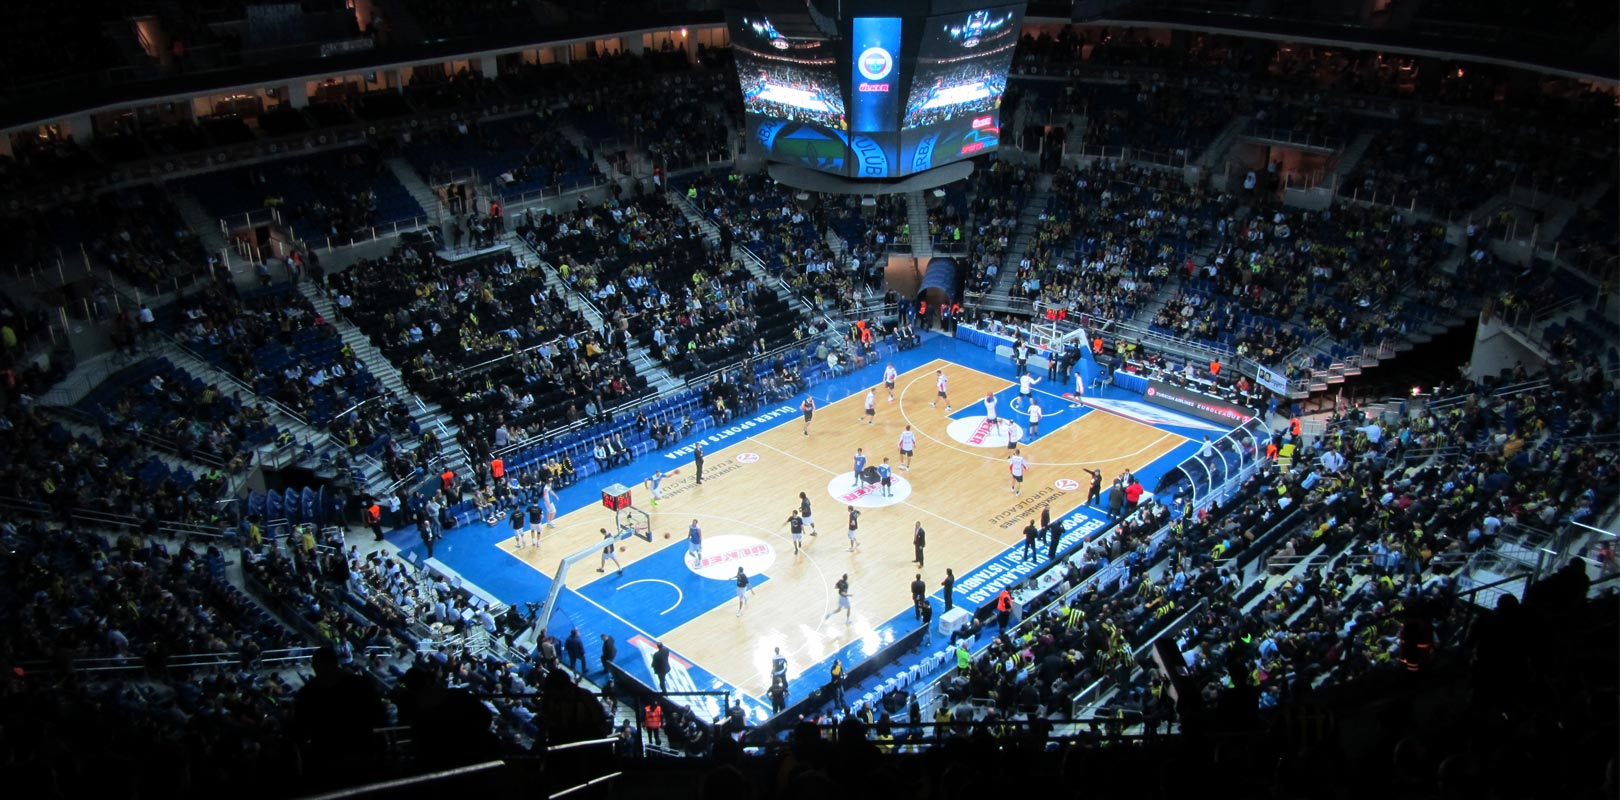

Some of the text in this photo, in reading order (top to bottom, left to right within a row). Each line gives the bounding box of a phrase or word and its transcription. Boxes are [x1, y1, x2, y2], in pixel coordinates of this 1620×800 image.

[754, 405, 797, 424] ÜLKER
[1156, 391, 1240, 421] TURKISH AIRLINES EUROLEAGUE
[708, 420, 757, 442] SPORTS
[661, 482, 700, 499] IRLINES
[989, 486, 1054, 525] EUROLEAGUE
[1000, 506, 1035, 529] AIRLINES
